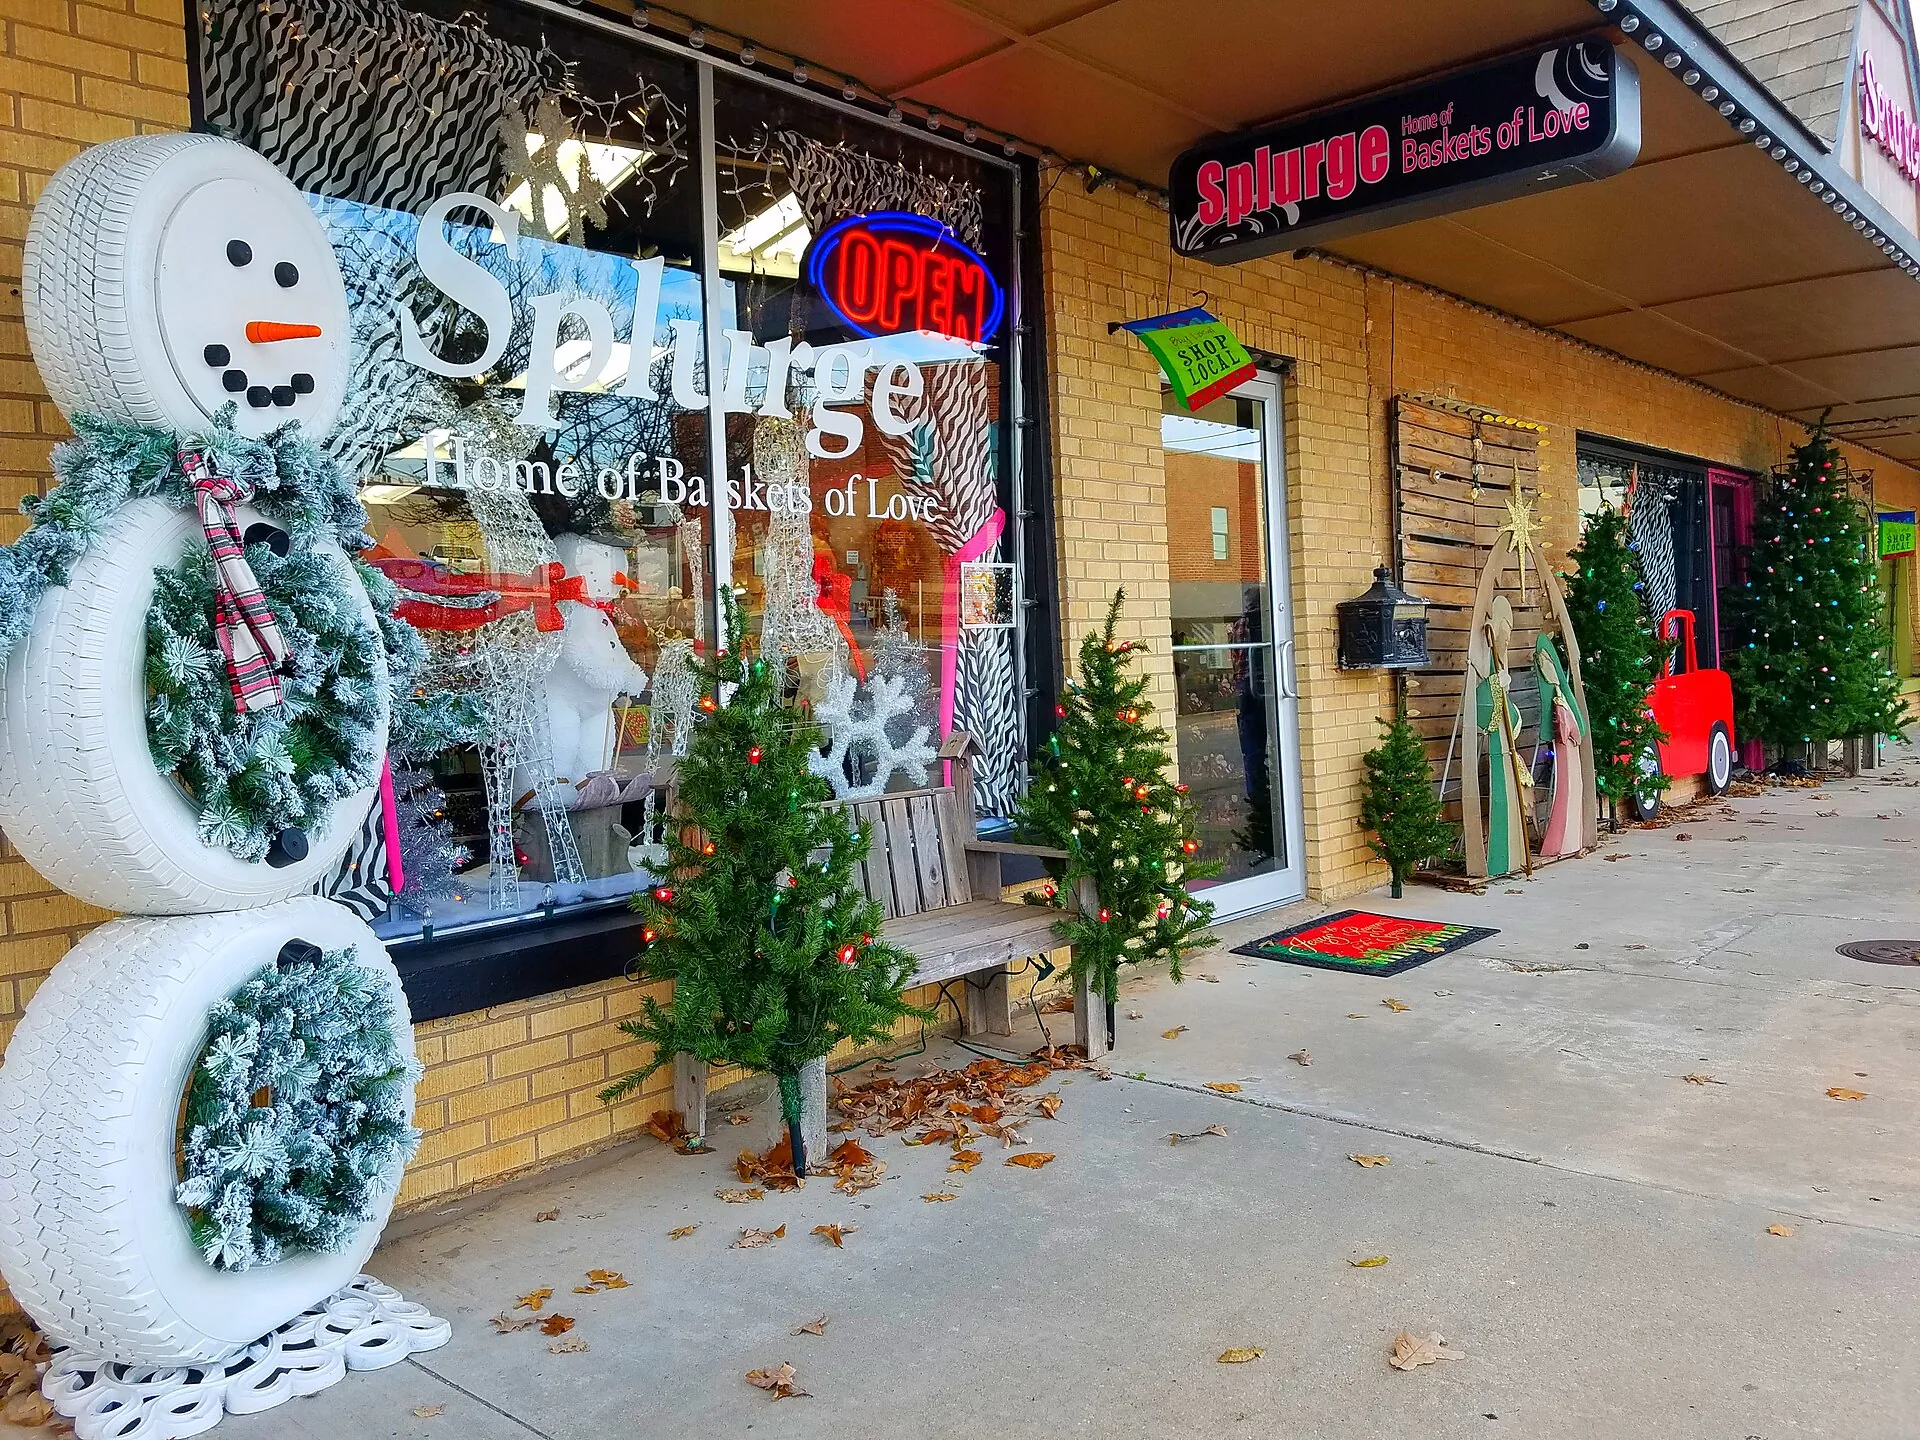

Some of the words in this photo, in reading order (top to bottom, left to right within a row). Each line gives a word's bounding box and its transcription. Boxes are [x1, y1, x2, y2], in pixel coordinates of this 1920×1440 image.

[1401, 113, 1438, 137] Home
[1439, 102, 1454, 128] of
[1402, 123, 1491, 175] Baskets
[1496, 106, 1524, 150] of
[1528, 102, 1591, 142] Love
[1197, 123, 1390, 227] Splurge
[838, 229, 986, 346] OPEN
[401, 191, 925, 460] Splurge
[1177, 334, 1228, 367] SHOP
[1187, 349, 1241, 387] LOCAL
[423, 434, 579, 498] Home
[597, 452, 648, 501] of
[659, 457, 813, 516] Baskets
[825, 473, 862, 518] of
[866, 478, 940, 523] Love
[1886, 533, 1912, 544] SHOP
[1886, 542, 1911, 553] LOCAL
